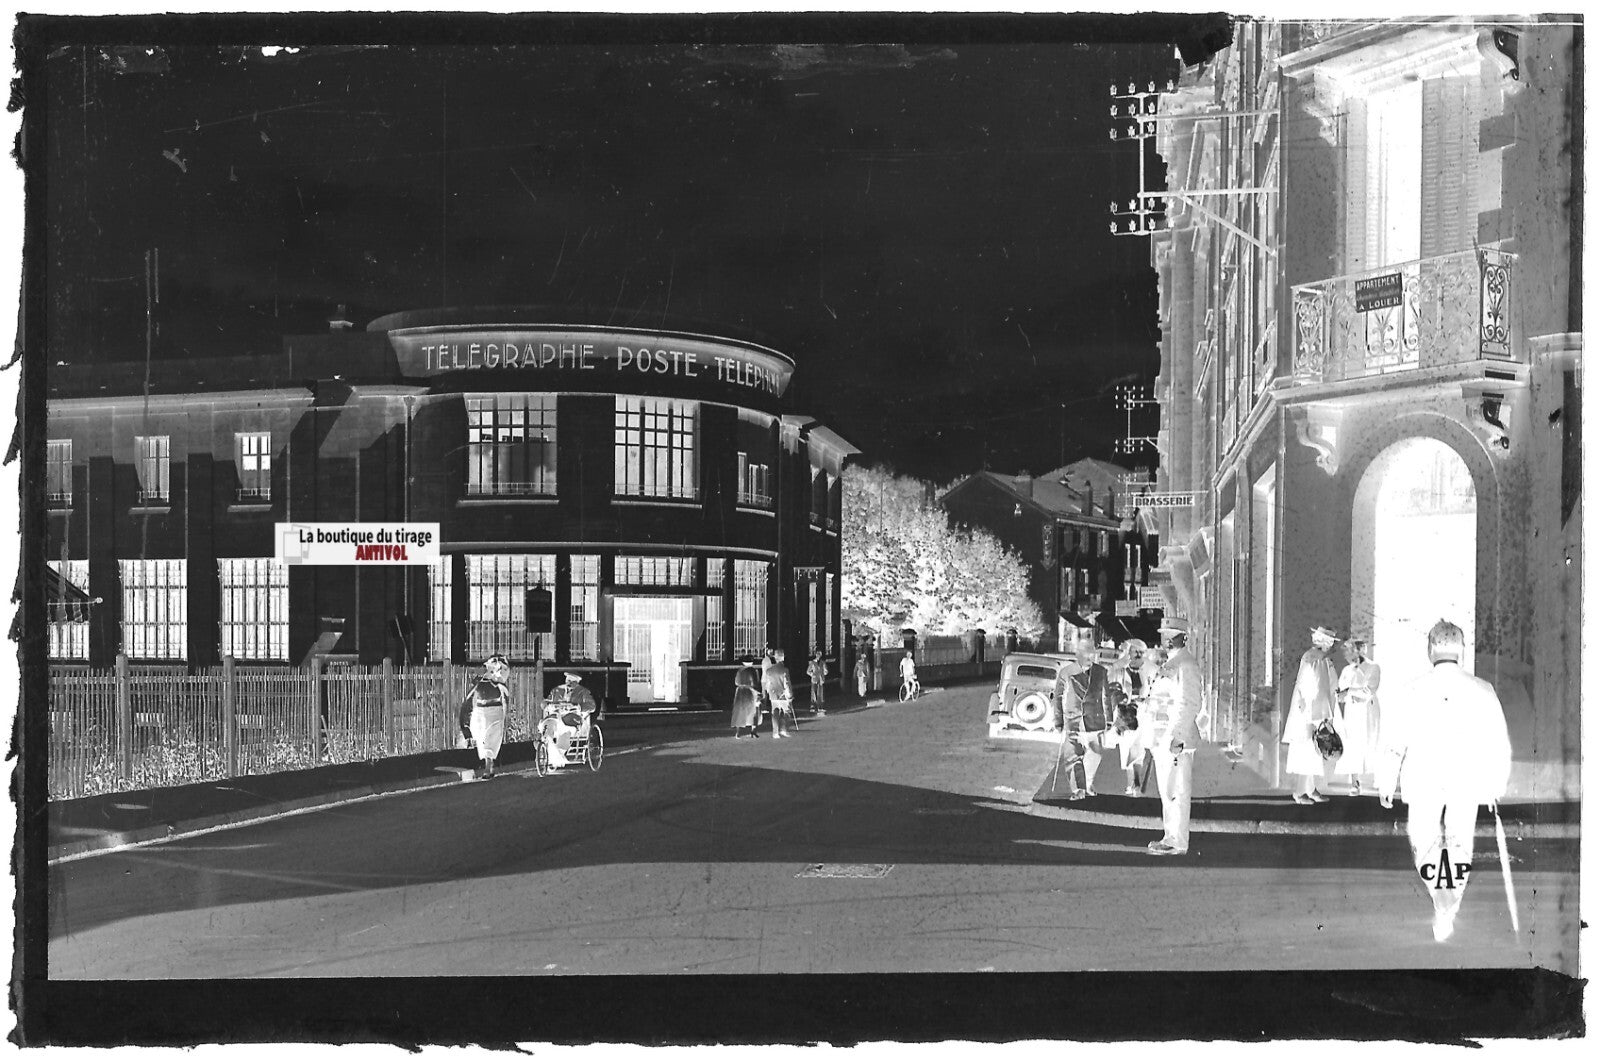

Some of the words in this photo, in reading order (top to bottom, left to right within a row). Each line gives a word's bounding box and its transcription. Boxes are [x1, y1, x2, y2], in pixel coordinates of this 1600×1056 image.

[1356, 275, 1399, 291] APPARTEMENT
[1368, 297, 1399, 309] LOUER
[617, 346, 698, 377] POSTE
[1135, 496, 1193, 506] BRASSERIE
